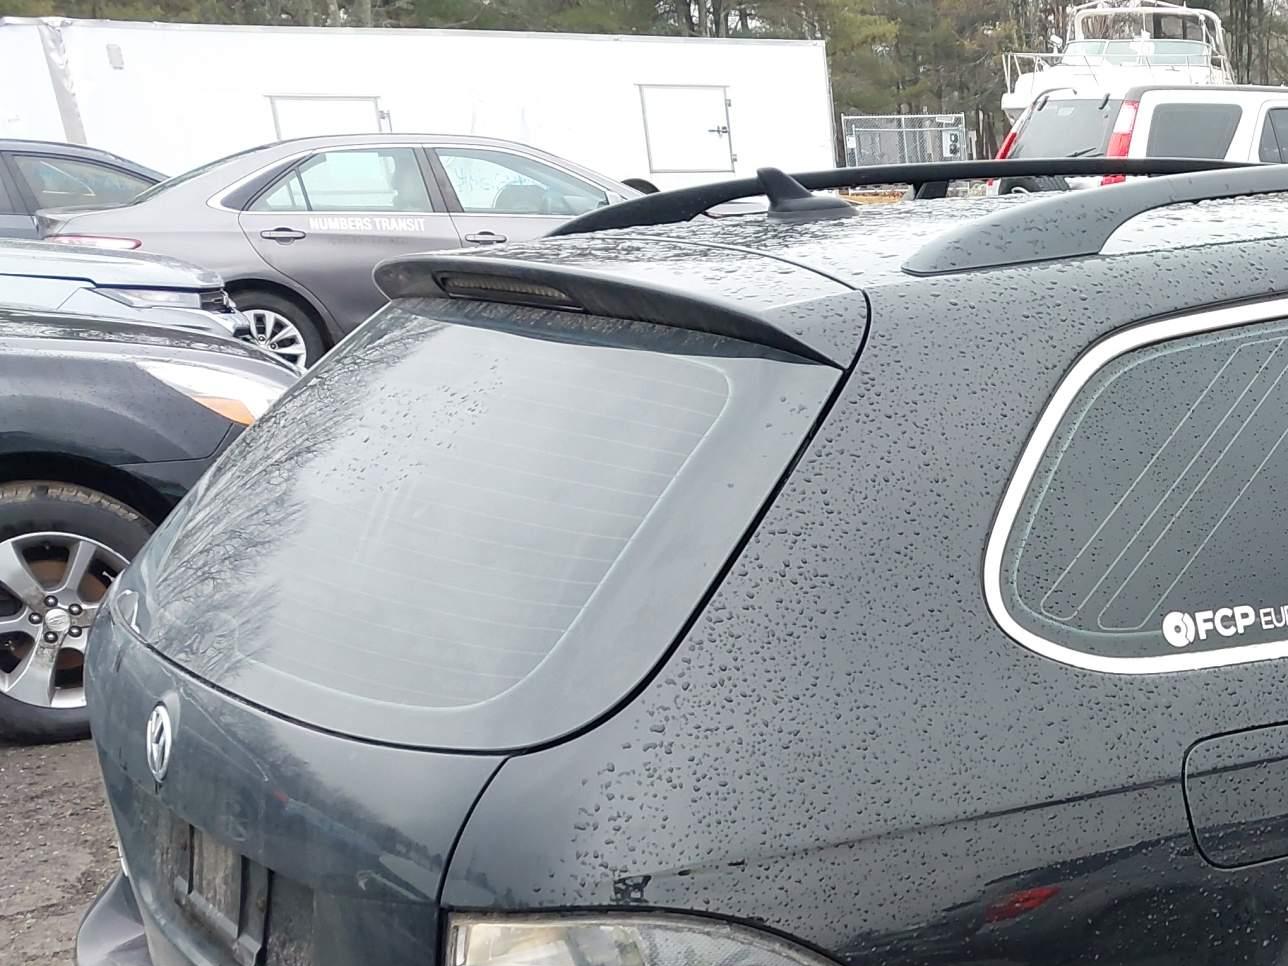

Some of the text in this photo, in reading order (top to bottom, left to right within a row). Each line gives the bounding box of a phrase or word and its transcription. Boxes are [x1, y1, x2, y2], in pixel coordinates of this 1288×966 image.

[309, 216, 425, 232] NUMBERS TRANSIT
[1195, 605, 1256, 640] FCP
